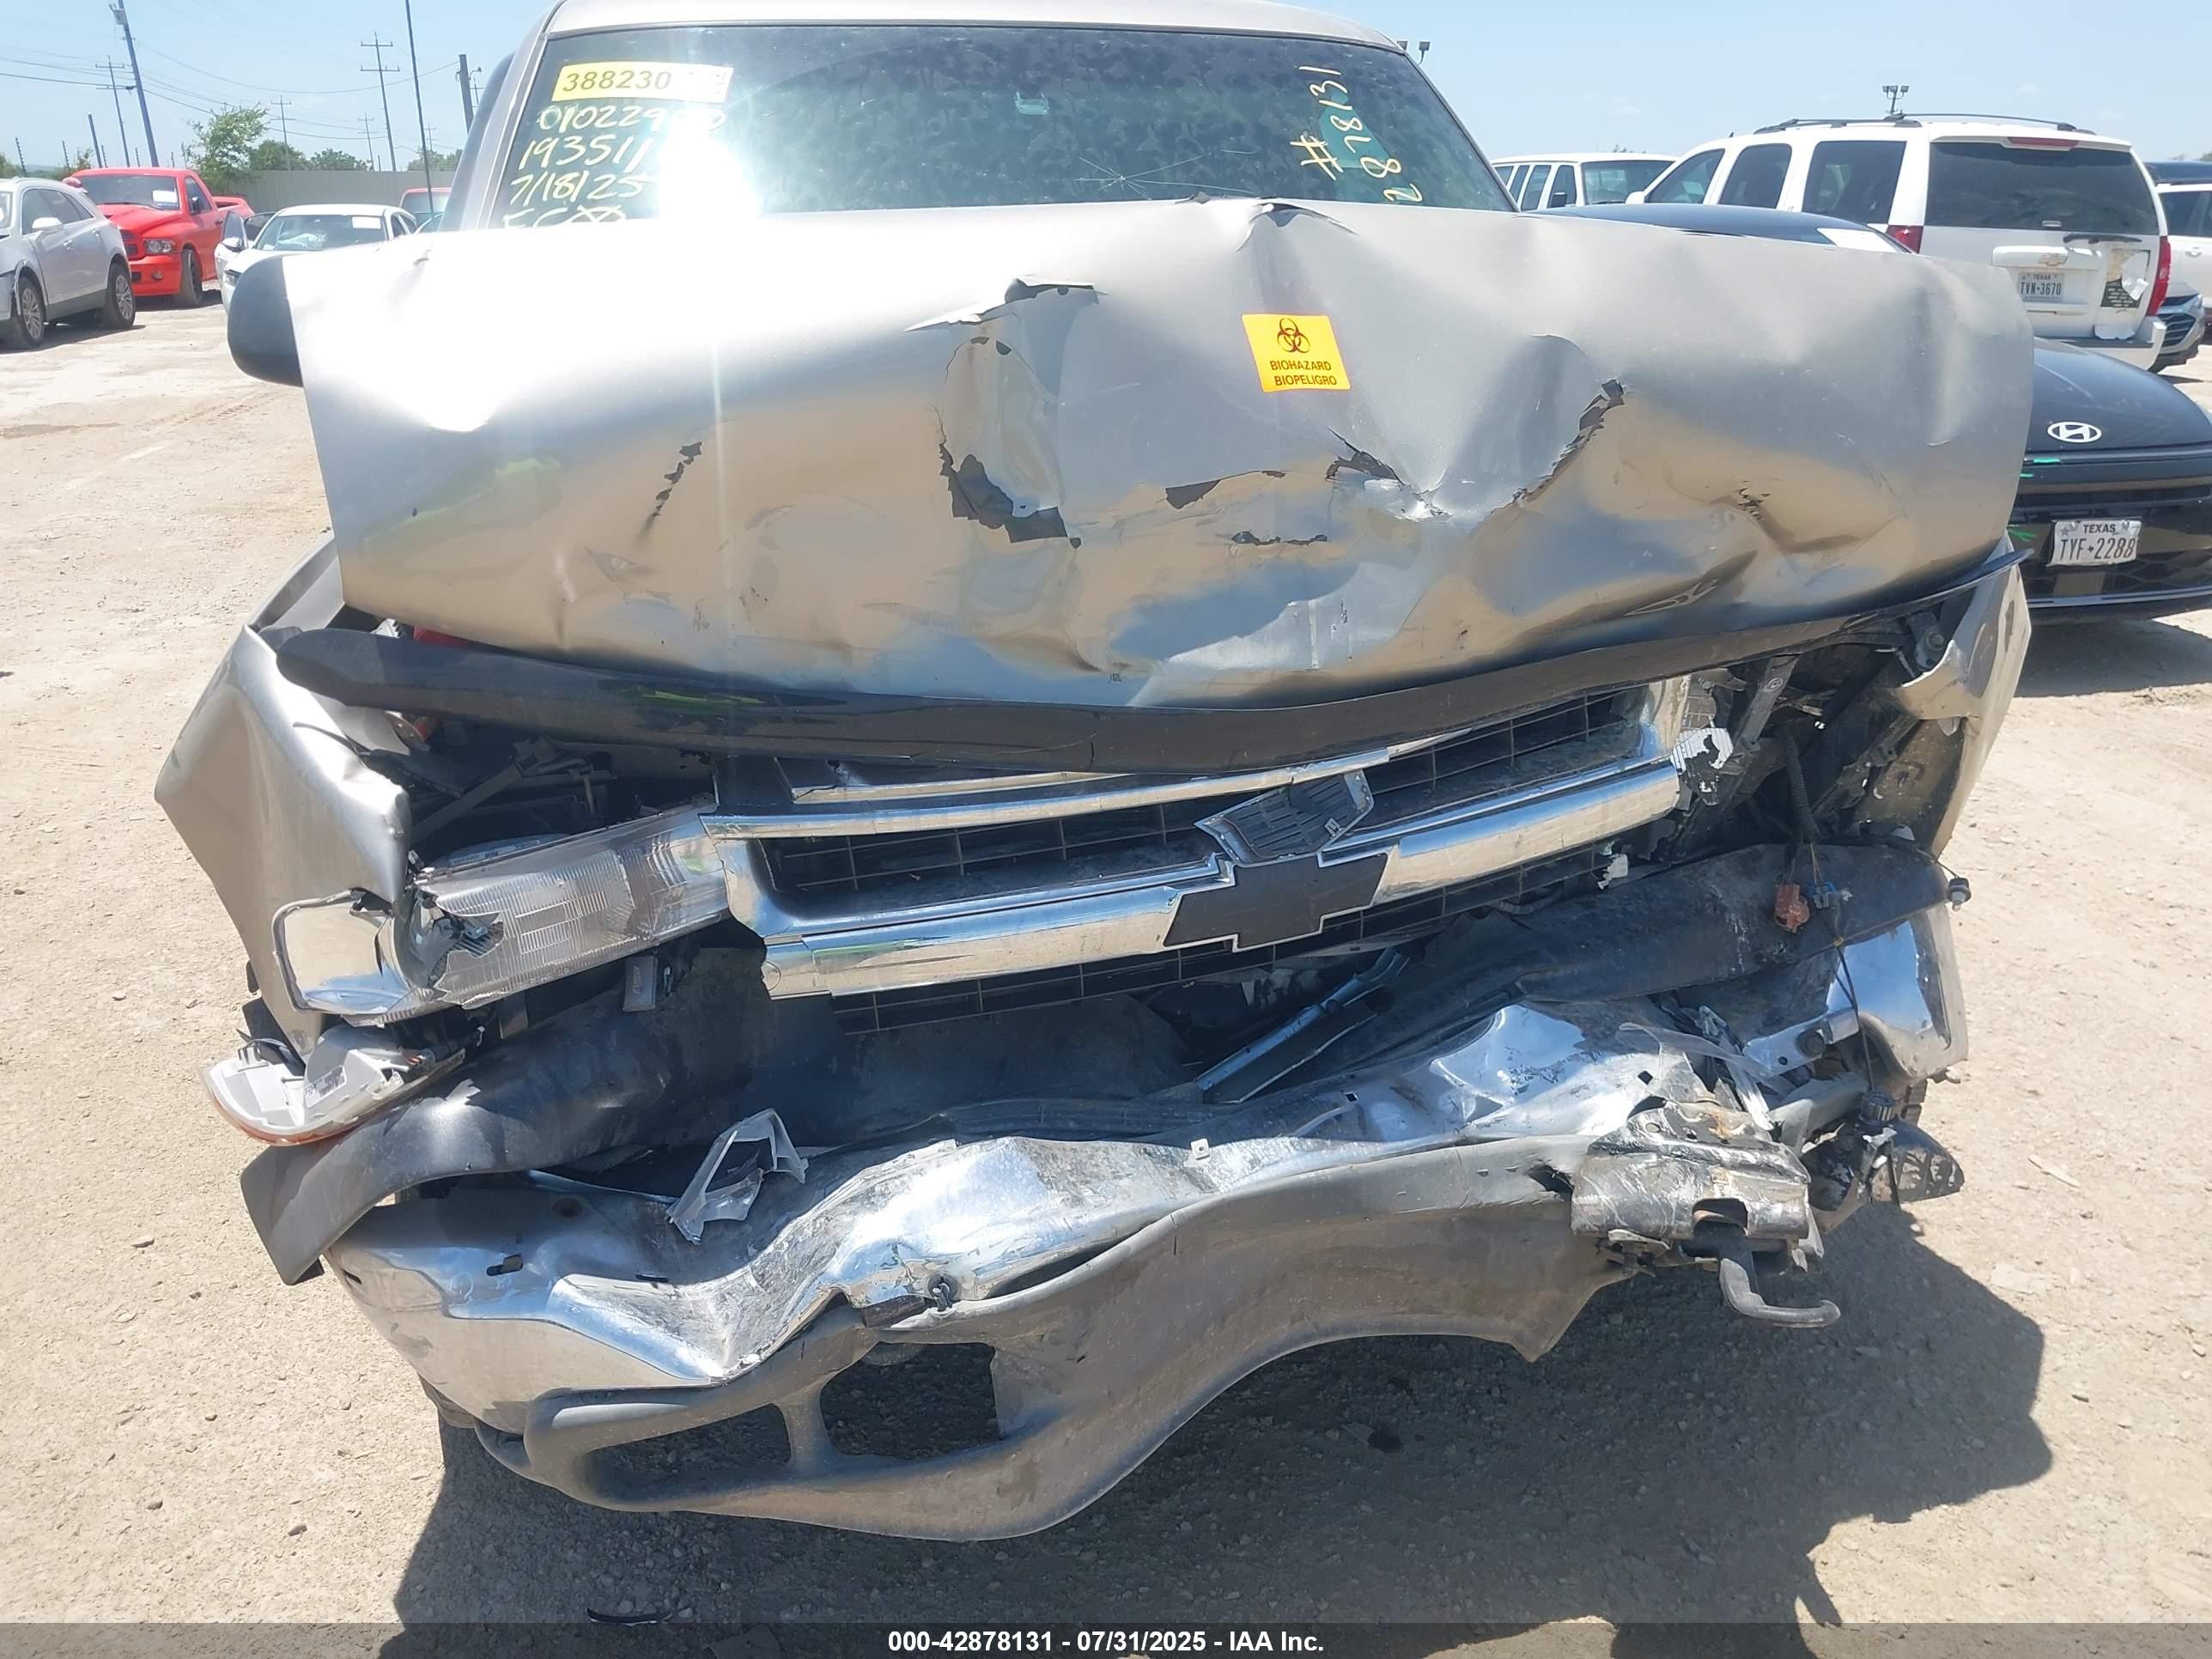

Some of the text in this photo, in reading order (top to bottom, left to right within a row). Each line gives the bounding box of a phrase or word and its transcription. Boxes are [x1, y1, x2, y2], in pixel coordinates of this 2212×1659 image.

[562, 70, 672, 92] 388230
[1290, 134, 1344, 181] #
[1270, 361, 1332, 371] BIOHAZARD
[1274, 375, 1337, 386] BIOPELIGRO
[2083, 524, 2116, 534] TEXAS
